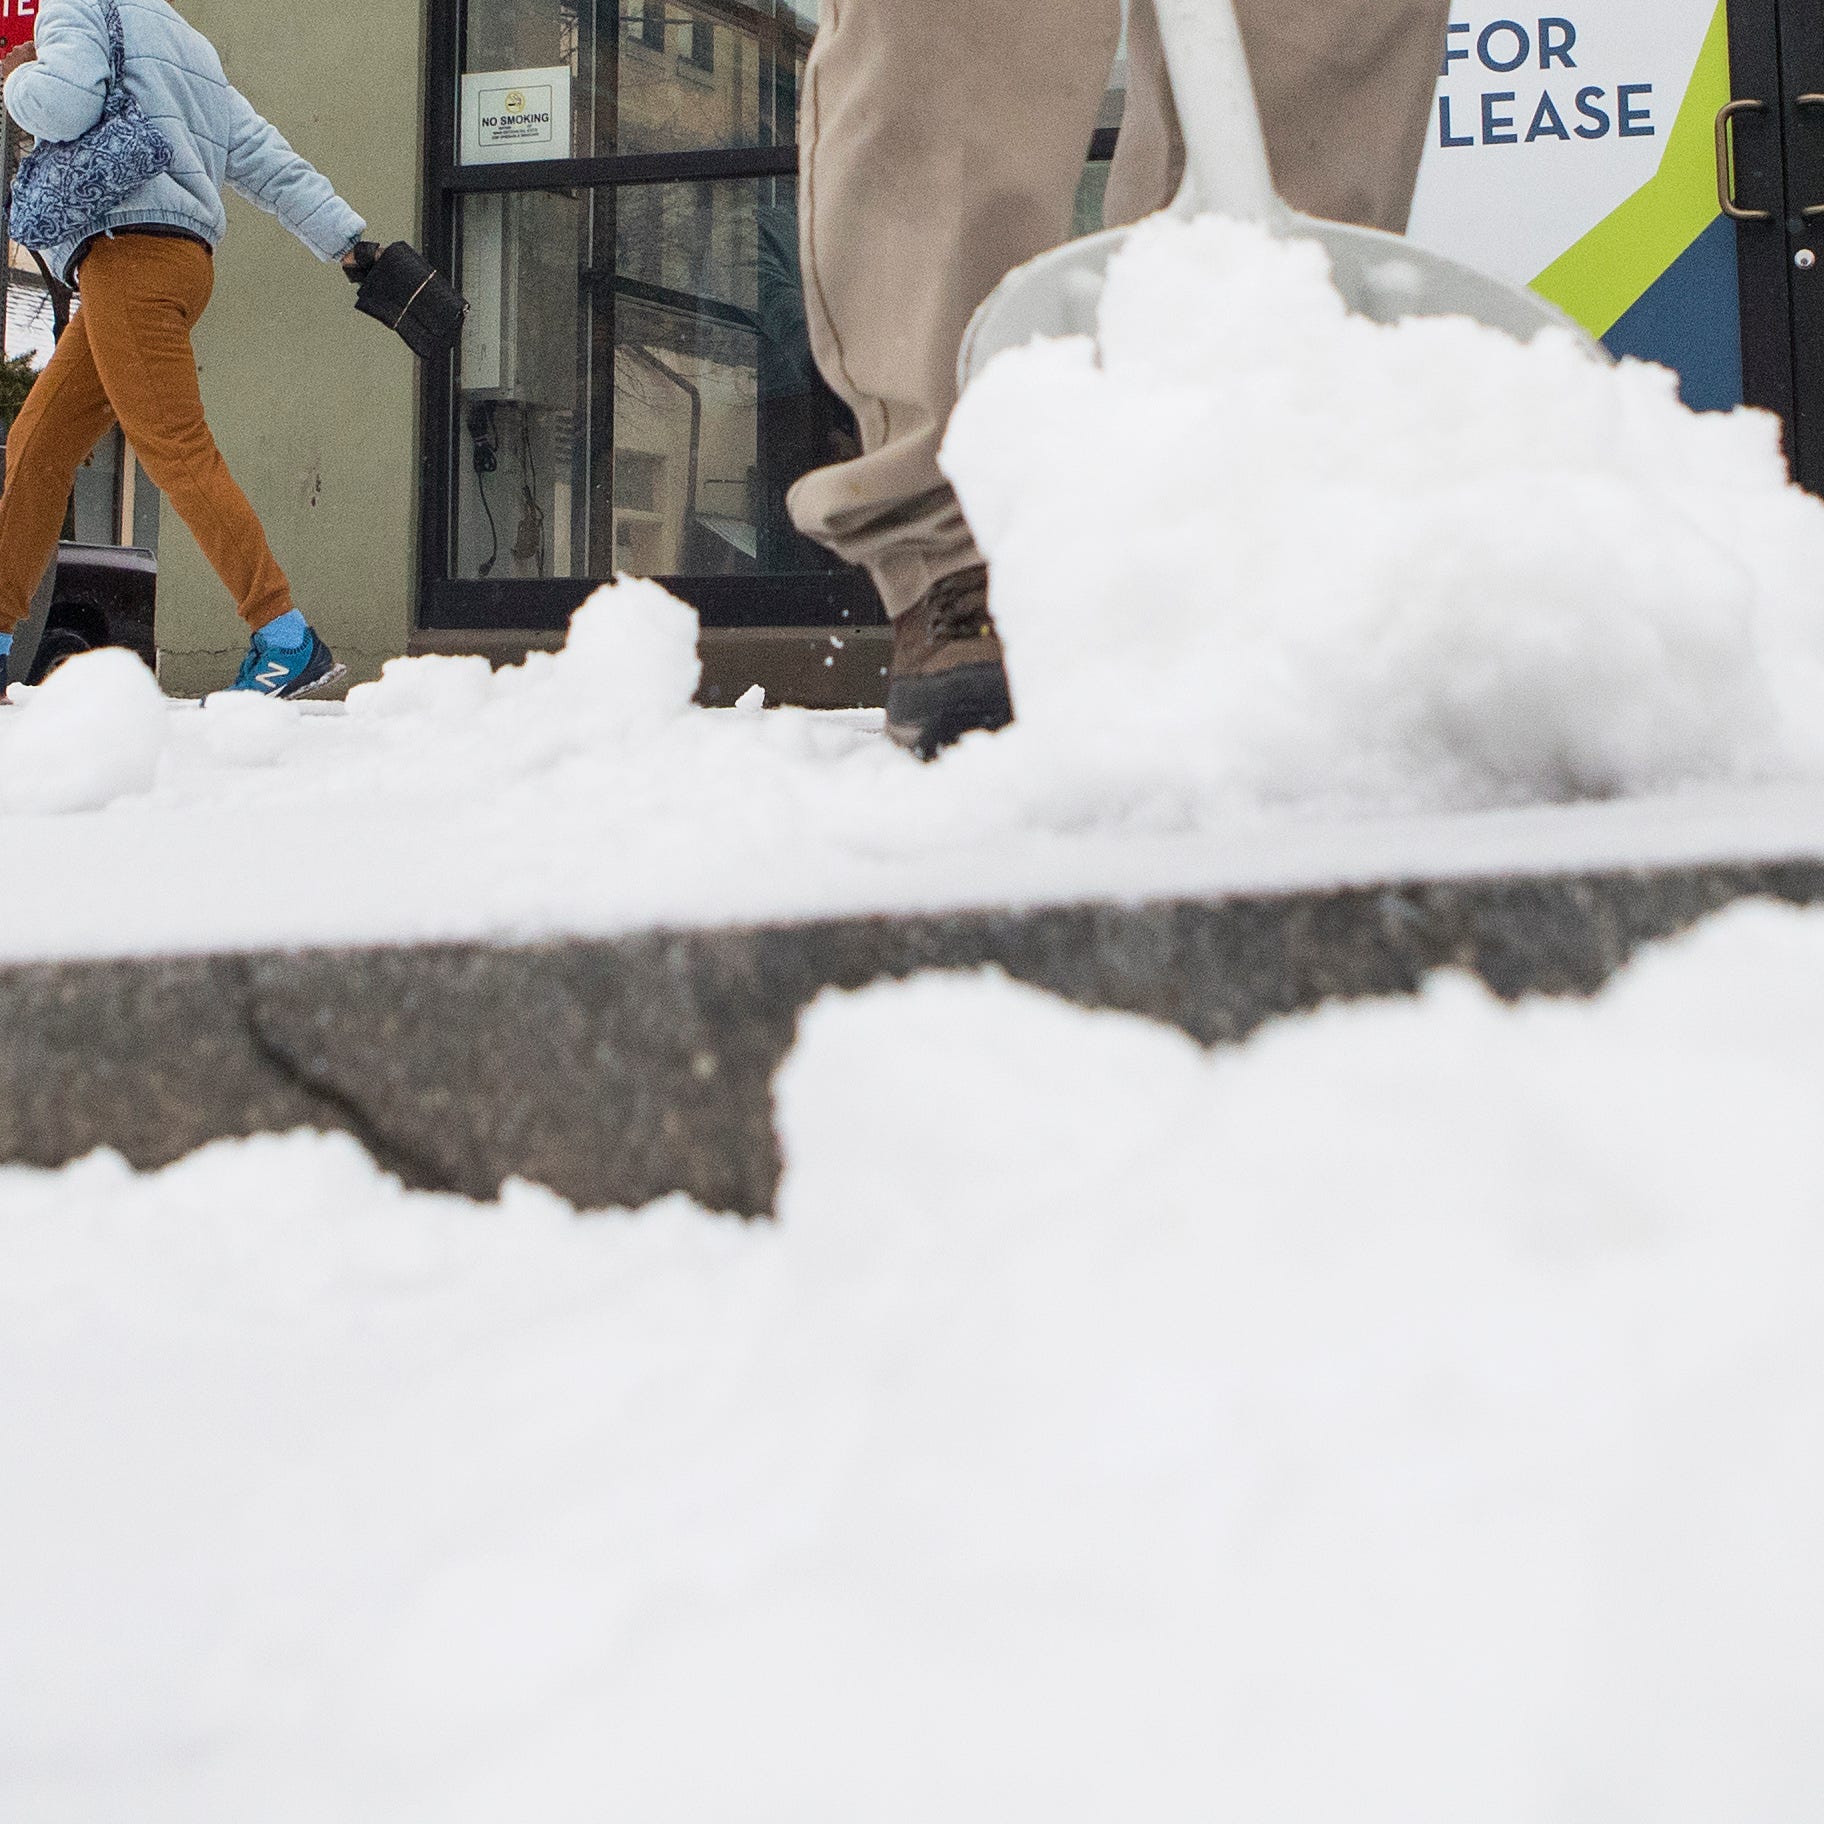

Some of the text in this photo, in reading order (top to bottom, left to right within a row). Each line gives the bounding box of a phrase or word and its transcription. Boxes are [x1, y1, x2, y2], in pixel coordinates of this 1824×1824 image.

[1440, 17, 1578, 76] FOR
[482, 117, 497, 127] NO
[501, 113, 549, 125] SMOKING
[1439, 84, 1655, 148] LEASE
